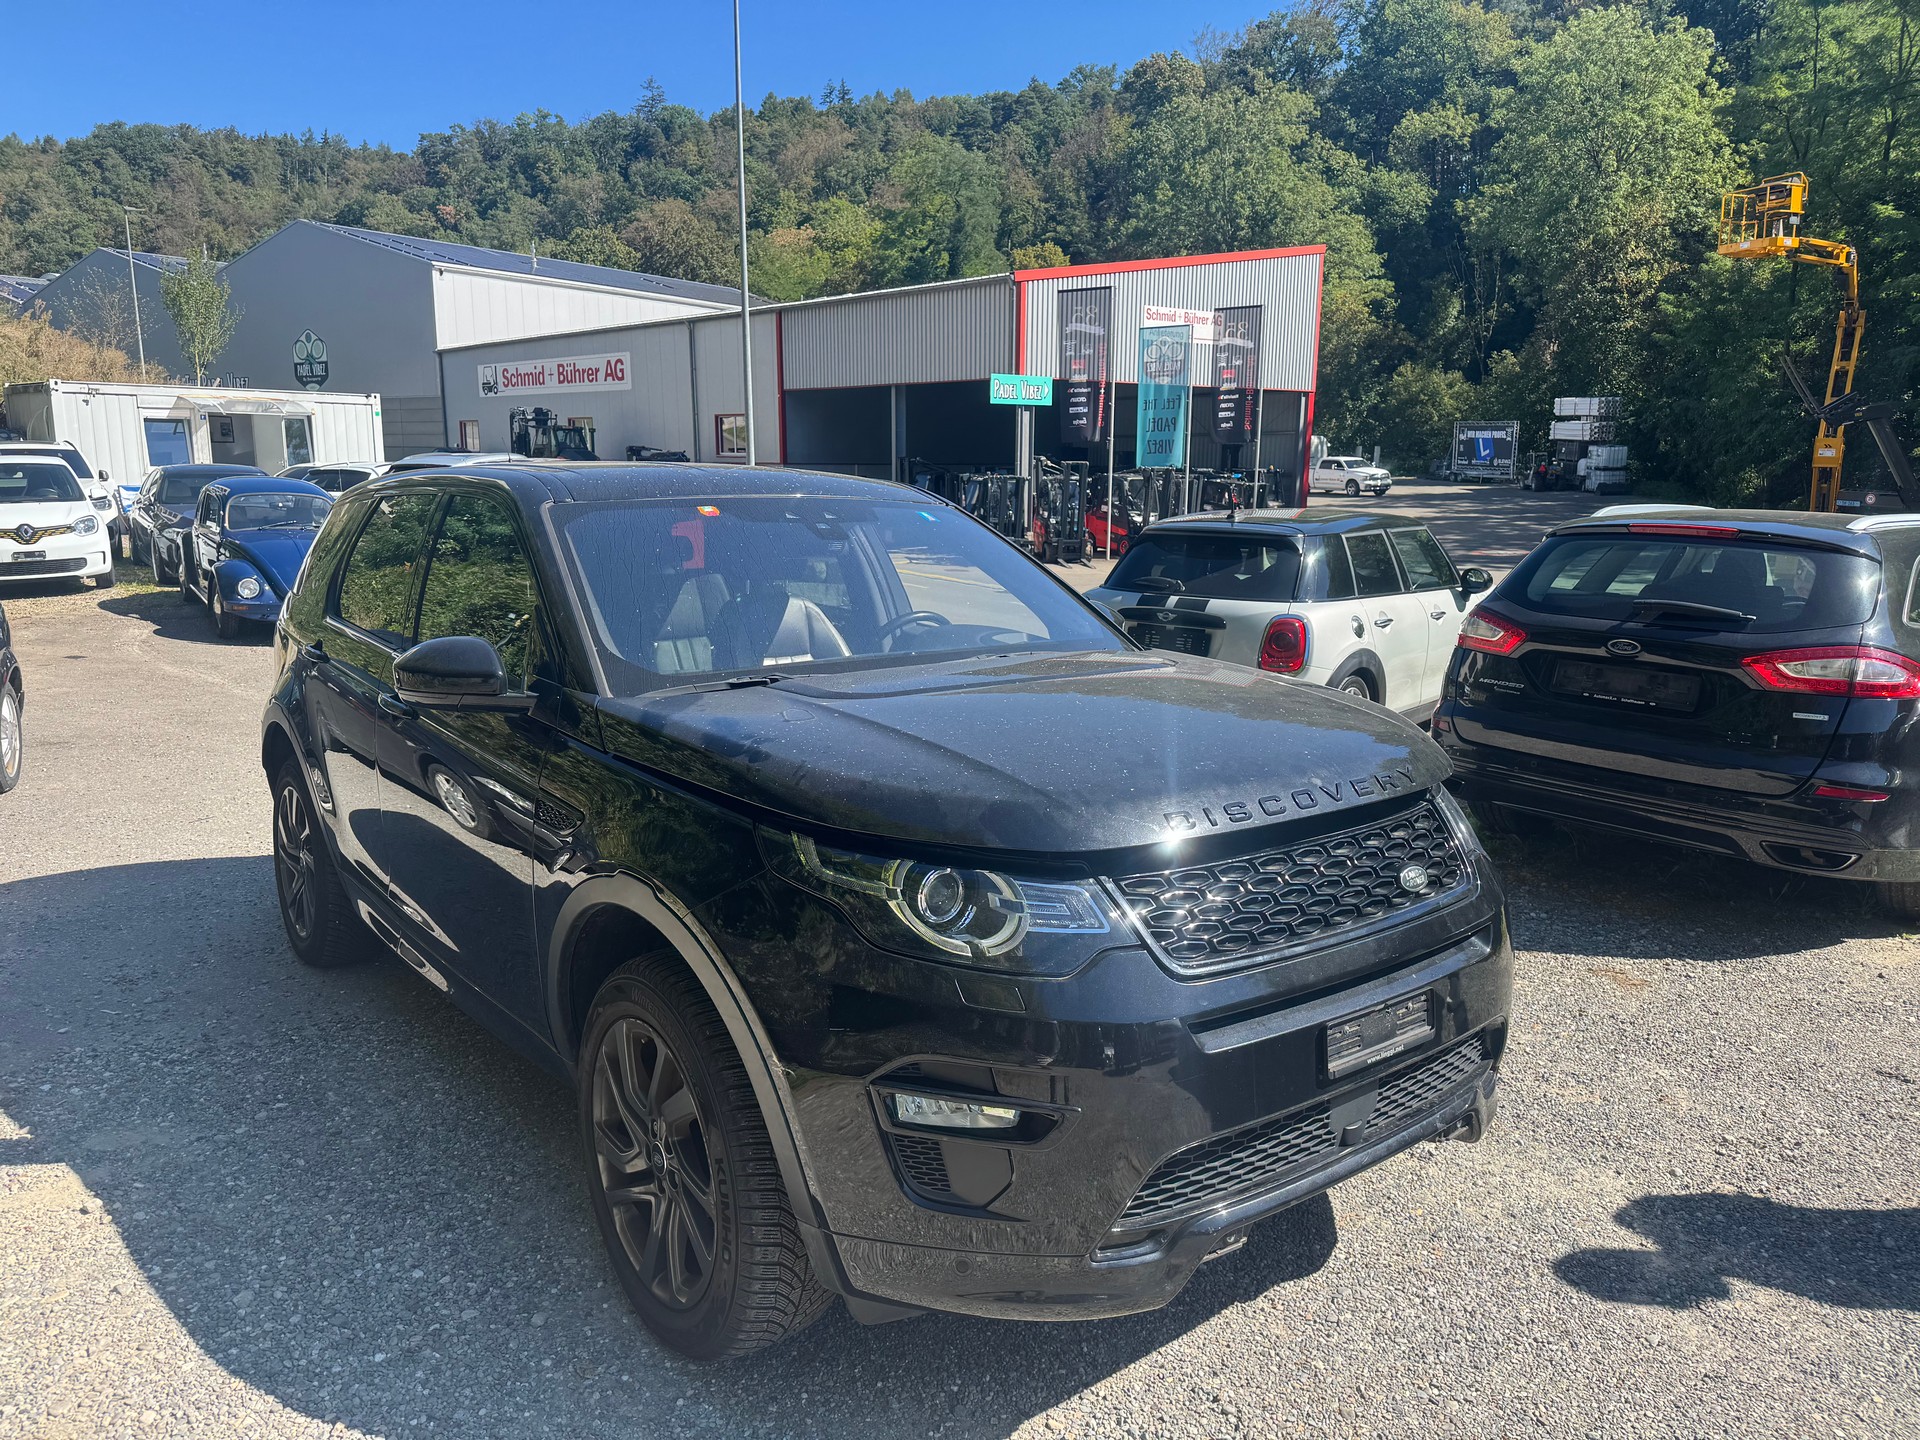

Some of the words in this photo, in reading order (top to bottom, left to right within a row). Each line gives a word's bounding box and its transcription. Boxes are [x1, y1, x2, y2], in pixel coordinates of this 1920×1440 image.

[1146, 308, 1177, 322] Schmid
[1184, 312, 1209, 326] Bührer
[1211, 314, 1223, 327] AG
[297, 364, 312, 376] PADEL
[312, 363, 326, 376] VIBEZ
[502, 365, 545, 388] Schmid
[548, 368, 554, 381] +
[557, 362, 600, 384] Bührer
[604, 358, 625, 382] AG
[994, 379, 1018, 400] PADEL
[1020, 380, 1043, 400] VIBEZ
[1478, 677, 1525, 689] MONDEO
[1162, 766, 1417, 831] DISCOVERY
[1404, 869, 1420, 881] LAND
[1409, 874, 1425, 887] ROVER
[714, 1157, 733, 1266] KUMHO
